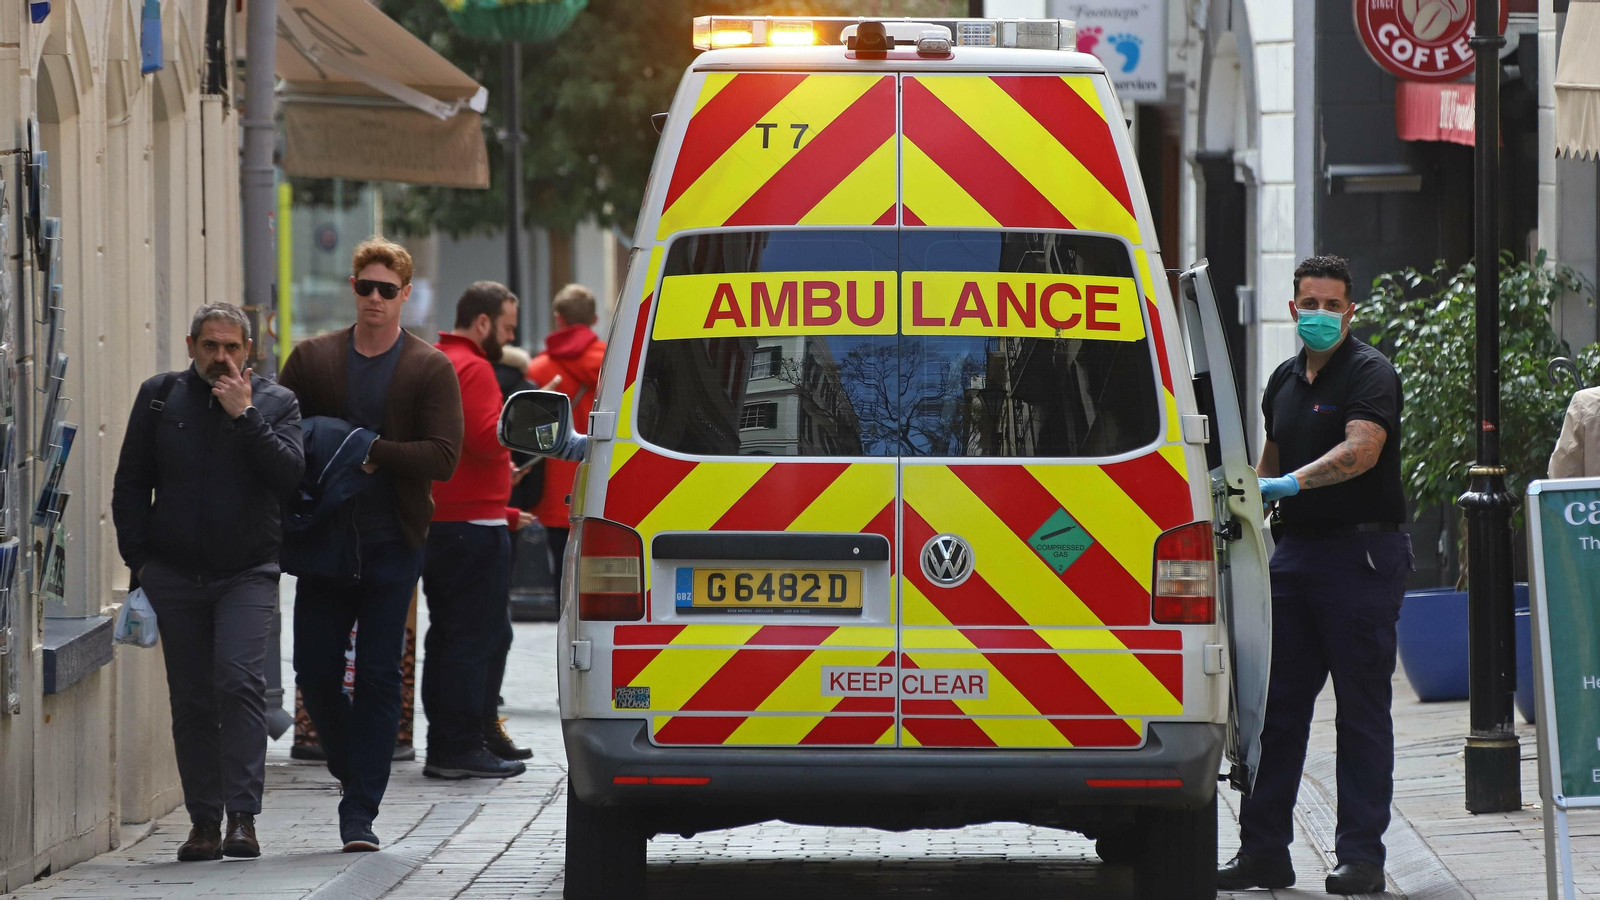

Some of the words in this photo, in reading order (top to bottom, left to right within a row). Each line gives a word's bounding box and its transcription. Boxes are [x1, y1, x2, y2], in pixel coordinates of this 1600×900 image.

[1115, 78, 1157, 89] services
[677, 593, 692, 601] GBZ
[830, 672, 894, 692] KEEP
[901, 674, 984, 695] CLEAR
